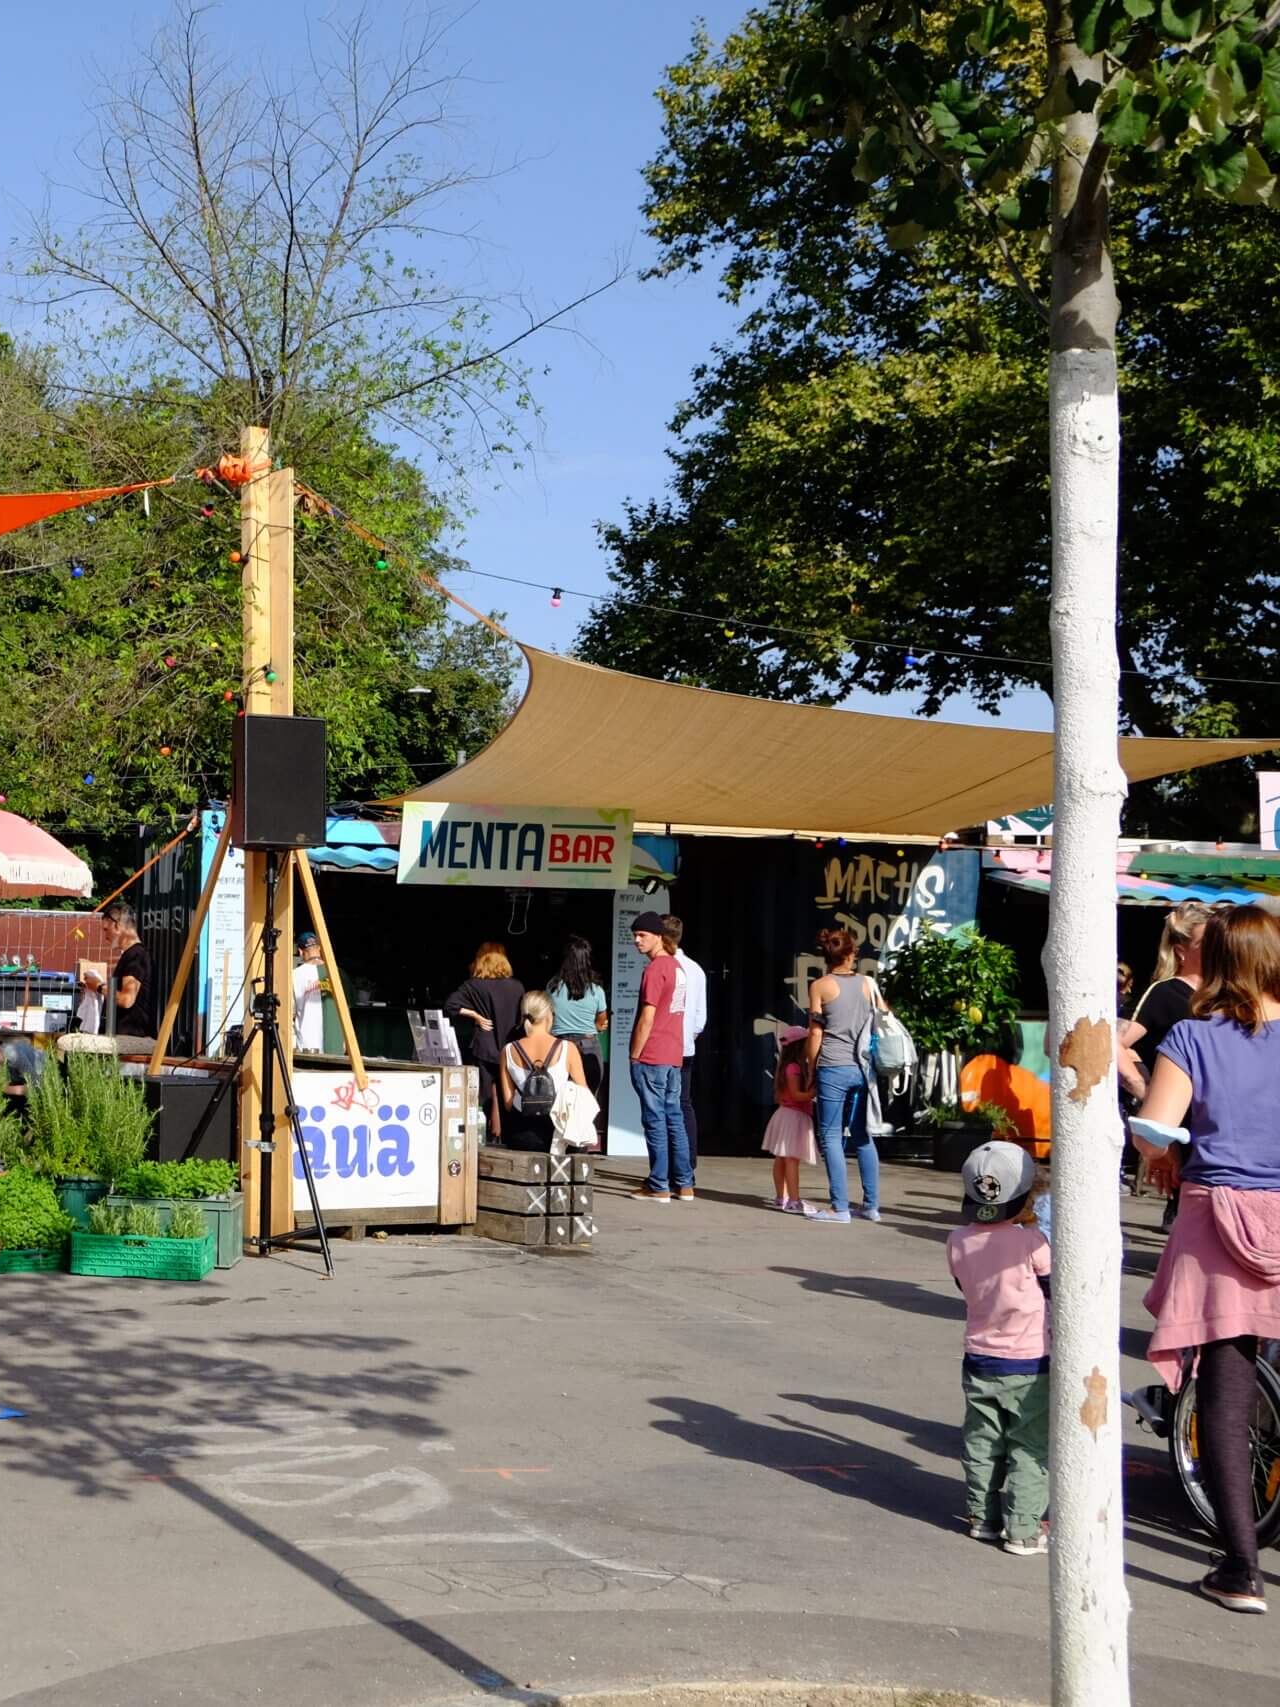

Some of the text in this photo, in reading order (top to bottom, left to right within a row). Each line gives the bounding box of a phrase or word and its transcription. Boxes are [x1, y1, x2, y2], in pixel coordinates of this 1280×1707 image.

[418, 820, 615, 871] MENTA BAR
[815, 854, 945, 908] MACHS
[292, 1104, 416, 1180] äuä
